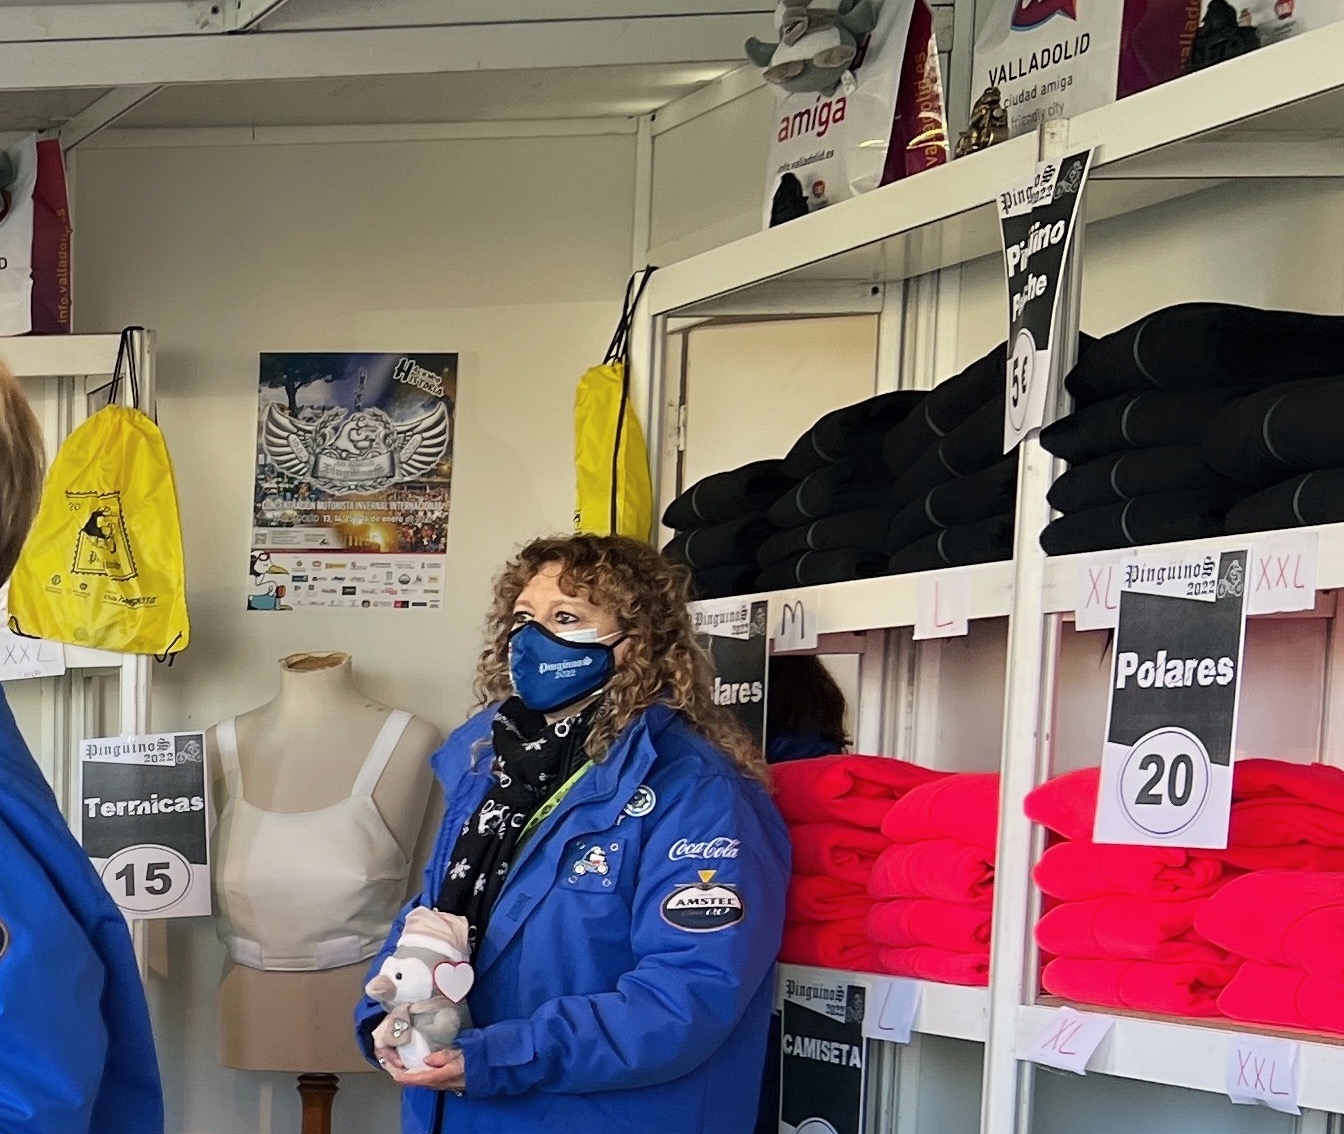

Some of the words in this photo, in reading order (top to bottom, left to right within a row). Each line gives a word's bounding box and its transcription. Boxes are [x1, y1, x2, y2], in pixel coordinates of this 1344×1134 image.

[988, 33, 1091, 87] VALLADOLID
[1003, 85, 1037, 110] ciudad
[1040, 74, 1073, 99] amiga
[1047, 102, 1065, 119] city
[778, 96, 846, 143] amiga
[1085, 565, 1117, 611] XL
[1186, 580, 1216, 596] 2022
[1255, 554, 1305, 592] XXL
[781, 600, 805, 640] M
[933, 579, 954, 628] L
[4, 642, 57, 666] XXL
[1116, 650, 1234, 689] Polares
[712, 676, 763, 706] lares
[143, 753, 174, 764] 2022
[1135, 753, 1195, 807] 20
[84, 793, 204, 818] Termicas
[668, 837, 741, 861] Coca-Cola
[115, 861, 173, 898] 15
[675, 897, 737, 907] AMSTEL
[877, 981, 895, 1031] L
[782, 1033, 862, 1068] CAMISETA
[1040, 1017, 1083, 1055] XL
[1237, 1048, 1290, 1095] XXL
